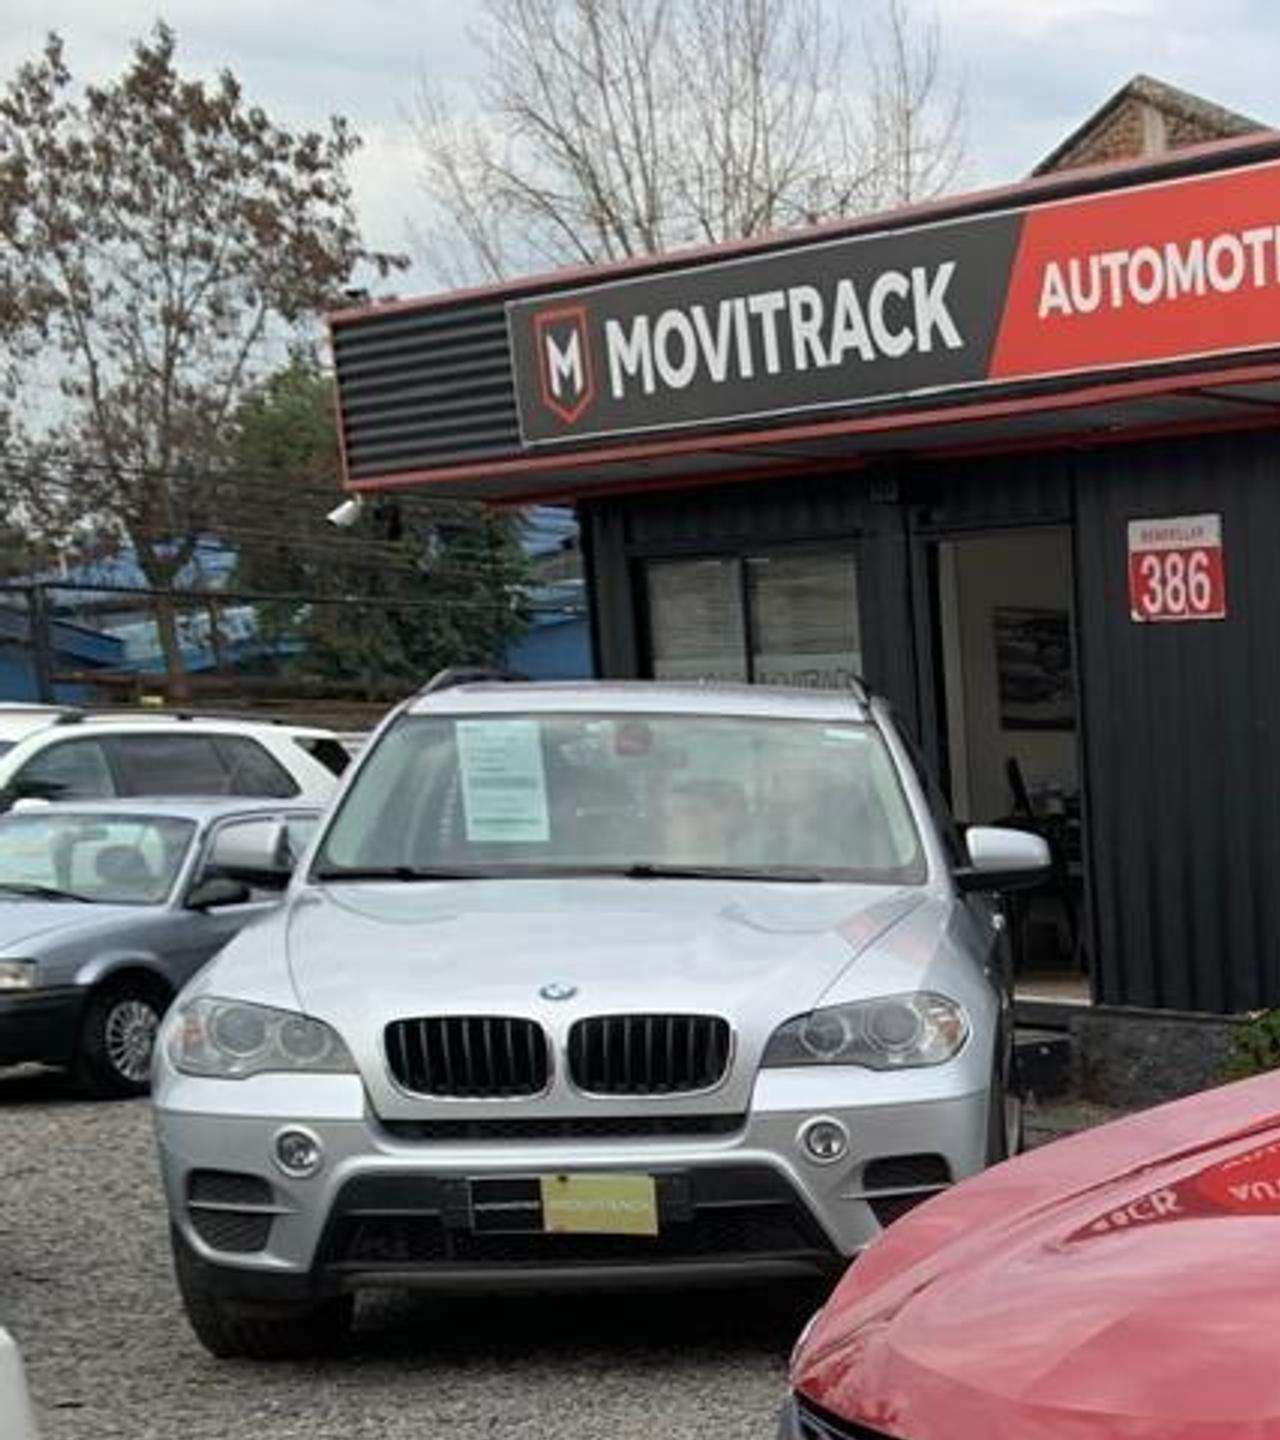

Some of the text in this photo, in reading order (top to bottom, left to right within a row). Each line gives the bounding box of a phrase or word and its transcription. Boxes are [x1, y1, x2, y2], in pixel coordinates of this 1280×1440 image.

[545, 328, 580, 398] M
[606, 262, 964, 399] MOVITRACK
[1140, 549, 1211, 615] 386
